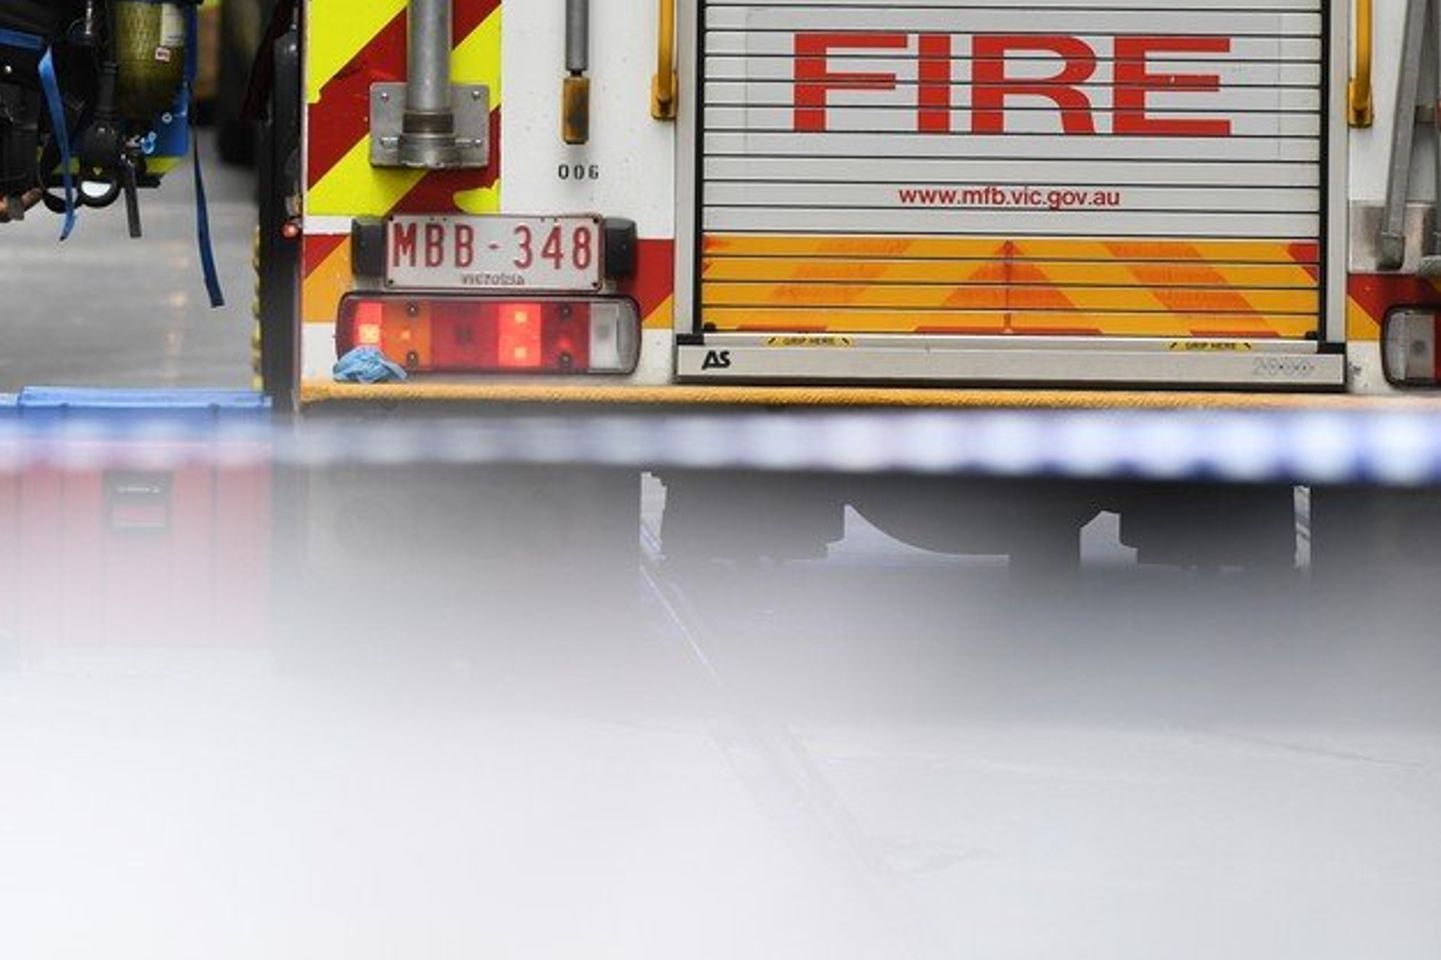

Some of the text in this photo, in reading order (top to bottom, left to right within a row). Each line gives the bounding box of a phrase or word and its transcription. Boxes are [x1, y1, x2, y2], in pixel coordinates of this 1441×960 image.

[793, 33, 1231, 136] FIRE
[558, 165, 599, 180] 006
[899, 187, 1120, 211] www.mfb.vic.gov.au
[702, 349, 731, 370] AS
